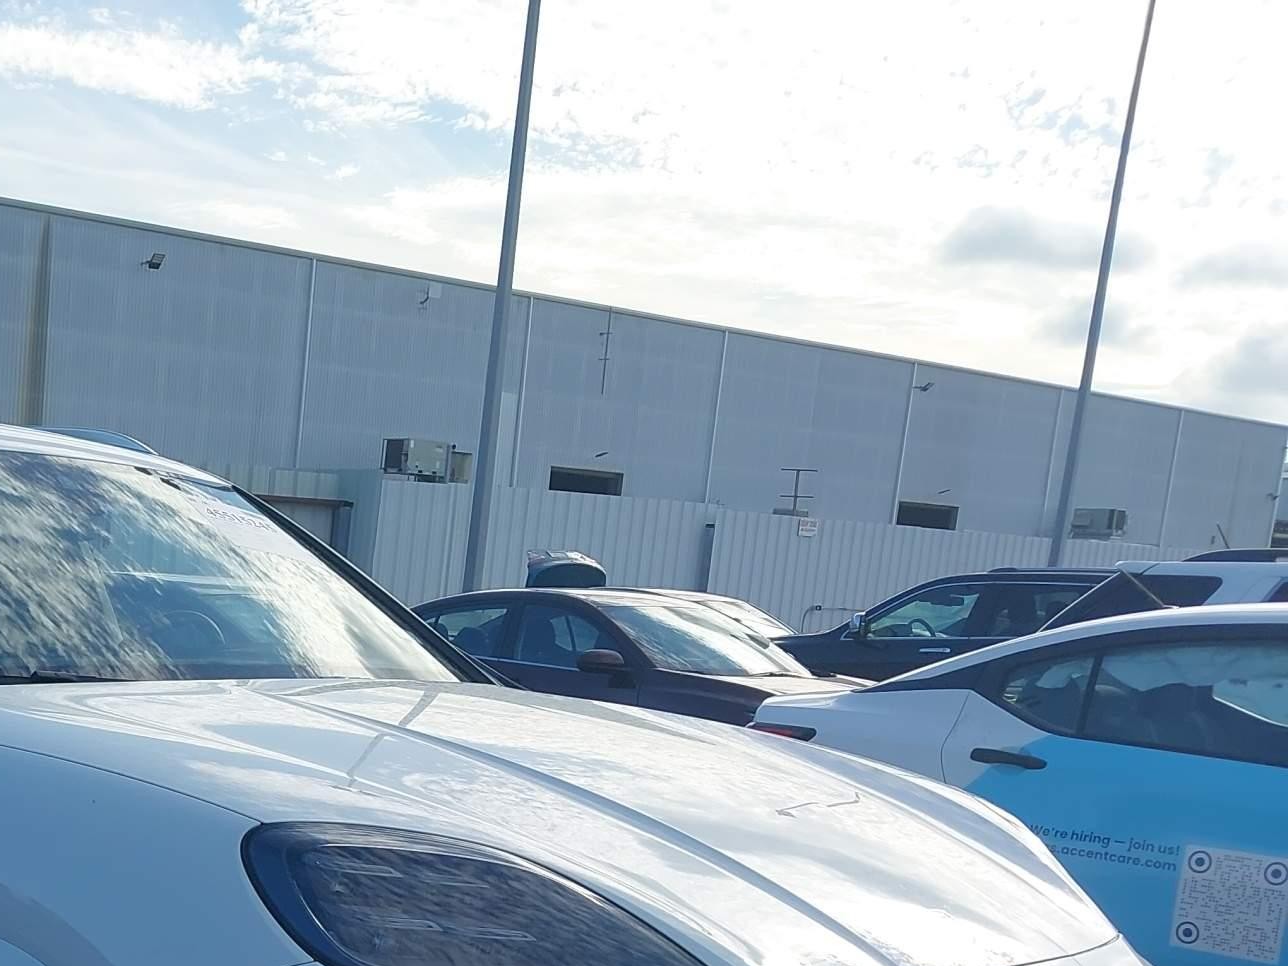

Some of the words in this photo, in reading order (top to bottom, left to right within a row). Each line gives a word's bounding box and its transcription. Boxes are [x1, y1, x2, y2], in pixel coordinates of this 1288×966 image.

[1030, 823, 1068, 839] We're
[1070, 829, 1111, 849] hiring
[1127, 837, 1155, 852] join
[1158, 844, 1181, 857] us!
